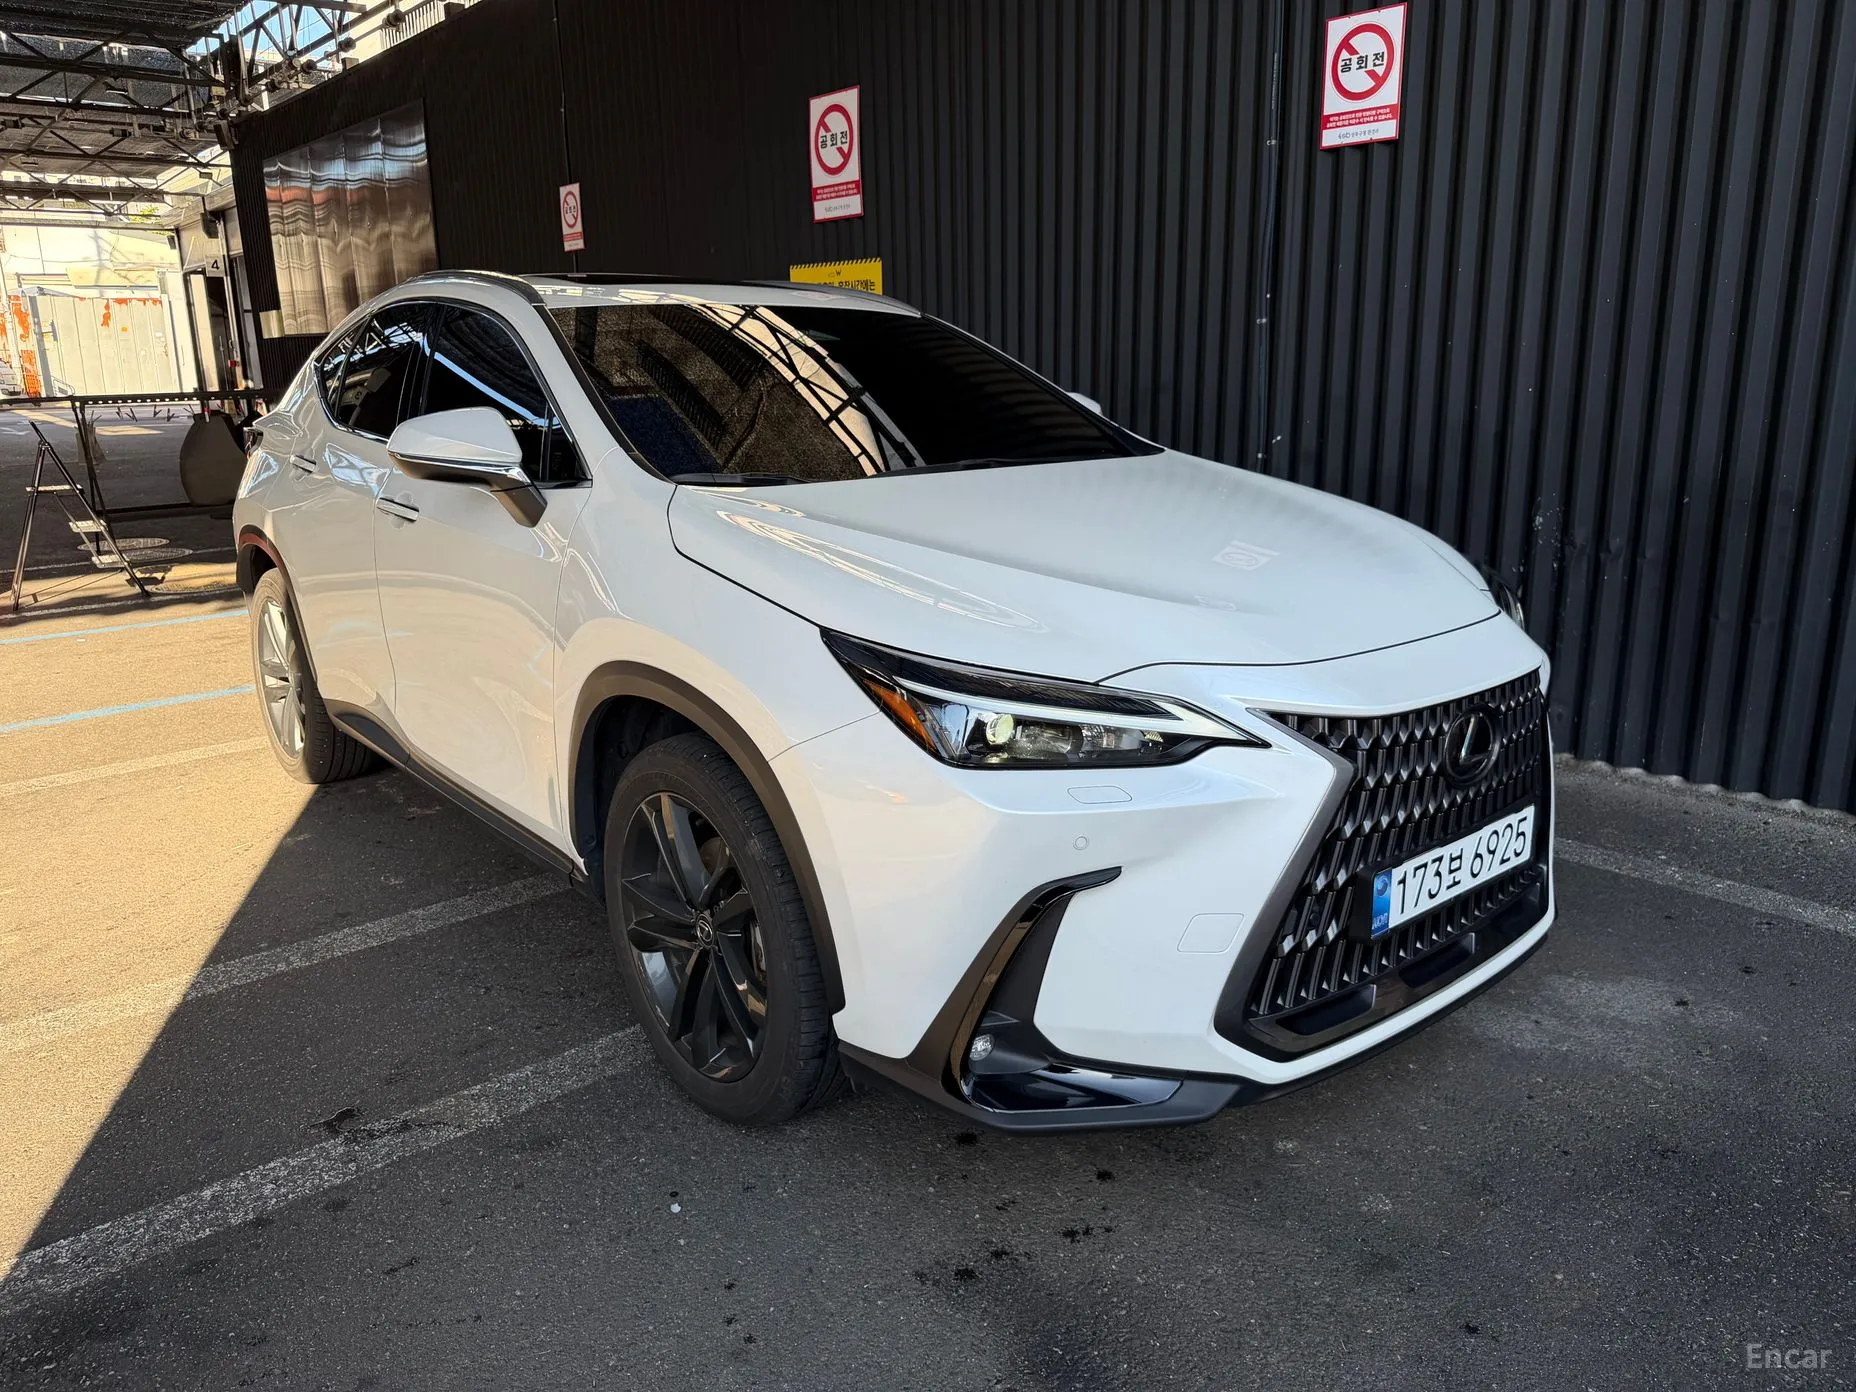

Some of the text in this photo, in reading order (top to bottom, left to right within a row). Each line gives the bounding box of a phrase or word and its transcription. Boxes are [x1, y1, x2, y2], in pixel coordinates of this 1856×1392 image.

[1340, 51, 1385, 73] 공회전
[820, 130, 848, 149] 공회전
[211, 259, 220, 271] 4
[1397, 816, 1528, 915] 173보 6925
